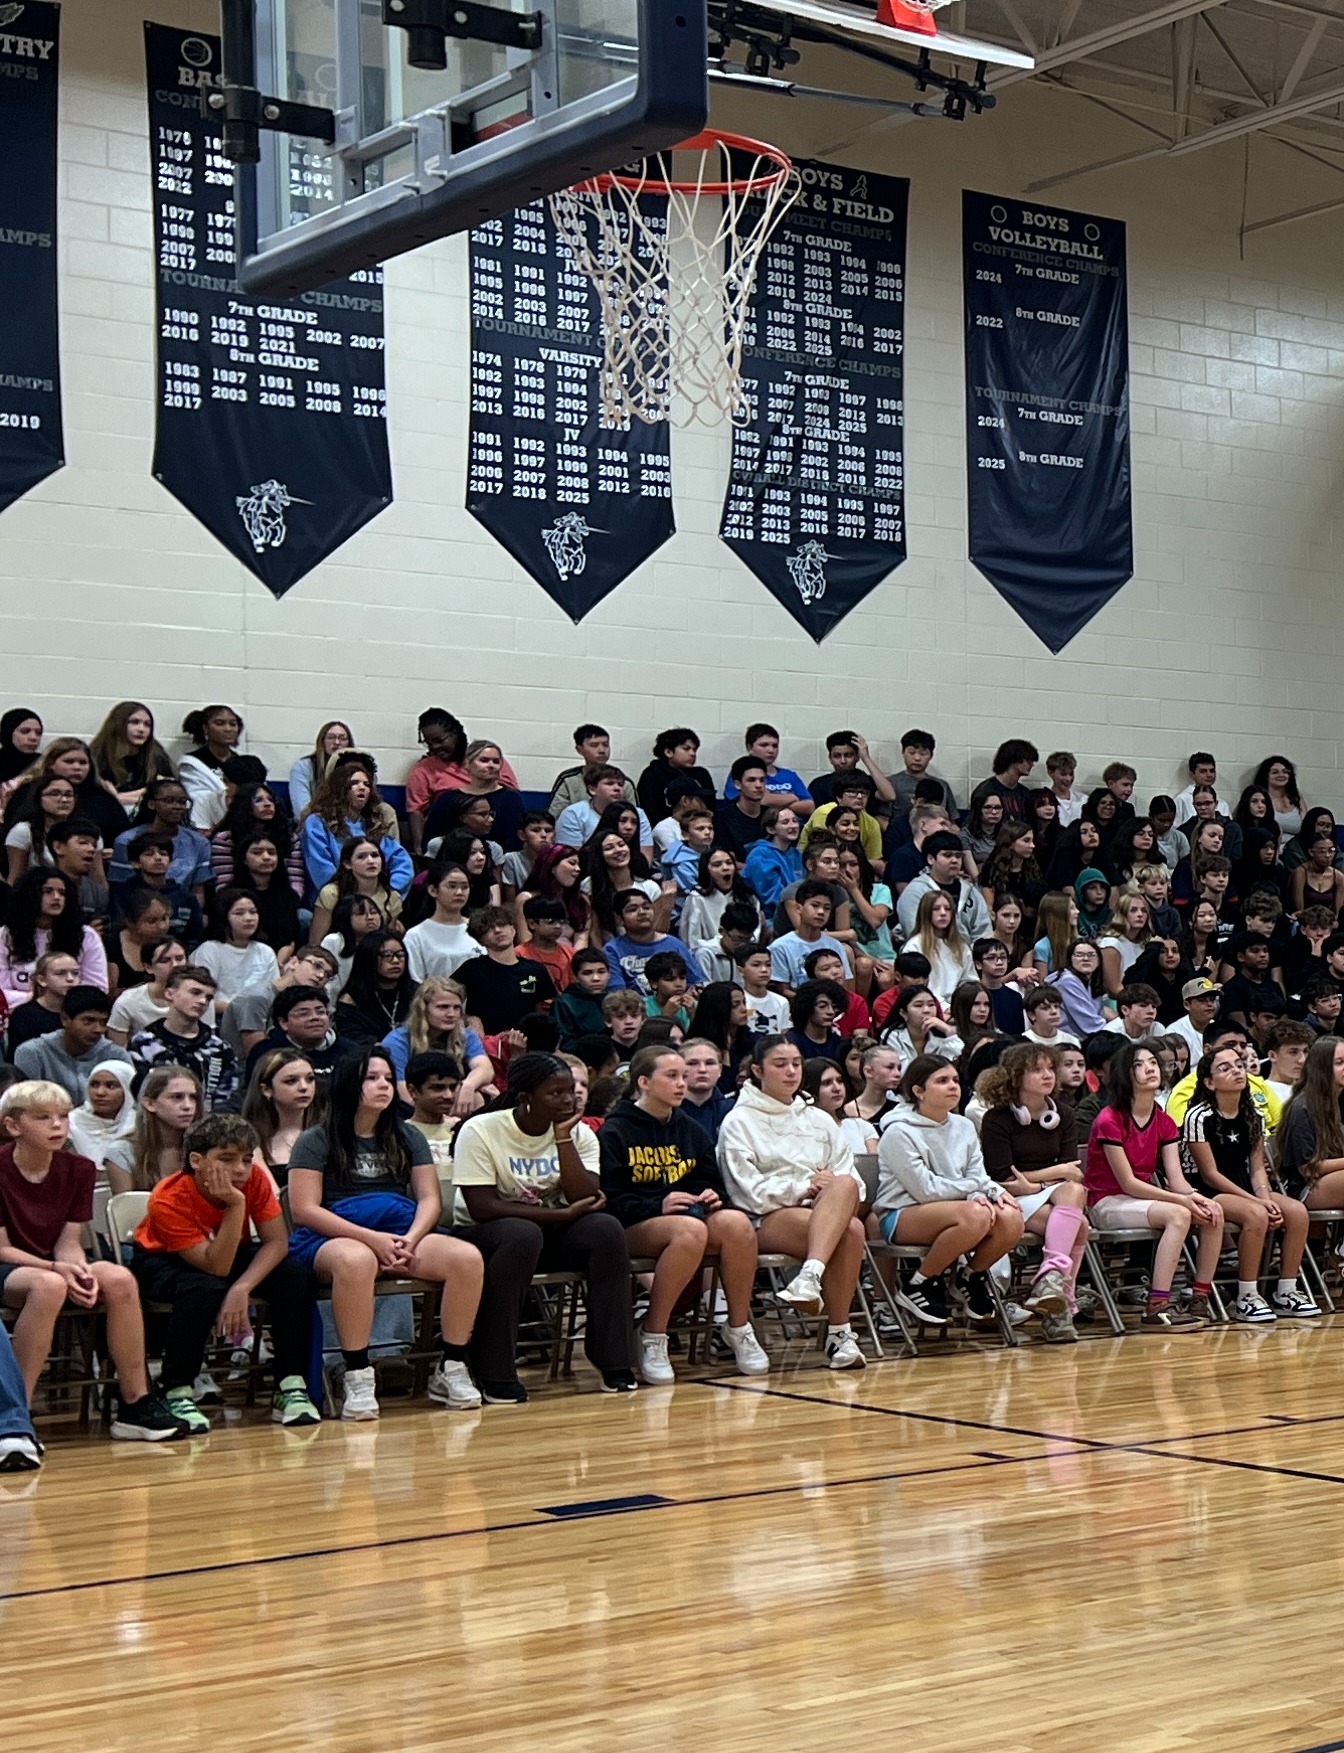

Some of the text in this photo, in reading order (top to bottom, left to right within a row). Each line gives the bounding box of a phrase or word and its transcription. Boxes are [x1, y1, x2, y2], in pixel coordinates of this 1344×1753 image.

[813, 194, 828, 211] &
[832, 197, 894, 223] FIELD
[1022, 210, 1070, 232] BOYS
[472, 230, 504, 247] 2017
[805, 235, 852, 253] GRADE
[988, 226, 1104, 261] VOLLEYBALL
[973, 241, 1120, 278] CONFERENCE CHAMPS
[976, 270, 1002, 284] 2024
[1015, 264, 1080, 285] 7TH GRADE
[301, 291, 383, 313] CHAMPS
[803, 290, 833, 304] 2024
[257, 305, 318, 326] GRADE
[805, 302, 853, 320] GRADE
[1016, 307, 1080, 328] 8TH GRADE
[557, 318, 590, 333] 2017
[976, 315, 1004, 329] 2022
[474, 318, 593, 347] TOURNAMENT
[259, 338, 296, 354] 2021
[350, 335, 385, 350] 2007
[766, 337, 833, 356] 2022 2025
[873, 342, 903, 355] 2017
[258, 353, 320, 372] GRADE
[538, 347, 603, 368] VARSITY
[742, 346, 901, 378] ONFERENCE CHAMPS
[805, 375, 850, 390] GRADE
[164, 394, 202, 410] 2017
[975, 386, 1123, 417] TOURNAMENT CHAMPS
[555, 412, 588, 426] 2017
[838, 419, 867, 433] 2025
[978, 416, 1004, 428] 2024
[1018, 408, 1083, 426] 7TH GRADE
[564, 428, 580, 441] JV
[805, 427, 850, 443] GRADE
[977, 458, 1005, 470] 2025
[1019, 451, 1084, 469] 8TH GRADE
[764, 463, 903, 489] 2017 2022
[470, 480, 590, 504] 2017 2025
[598, 481, 630, 494] 2012
[761, 532, 791, 544] 2025
[837, 526, 866, 539] 2017
